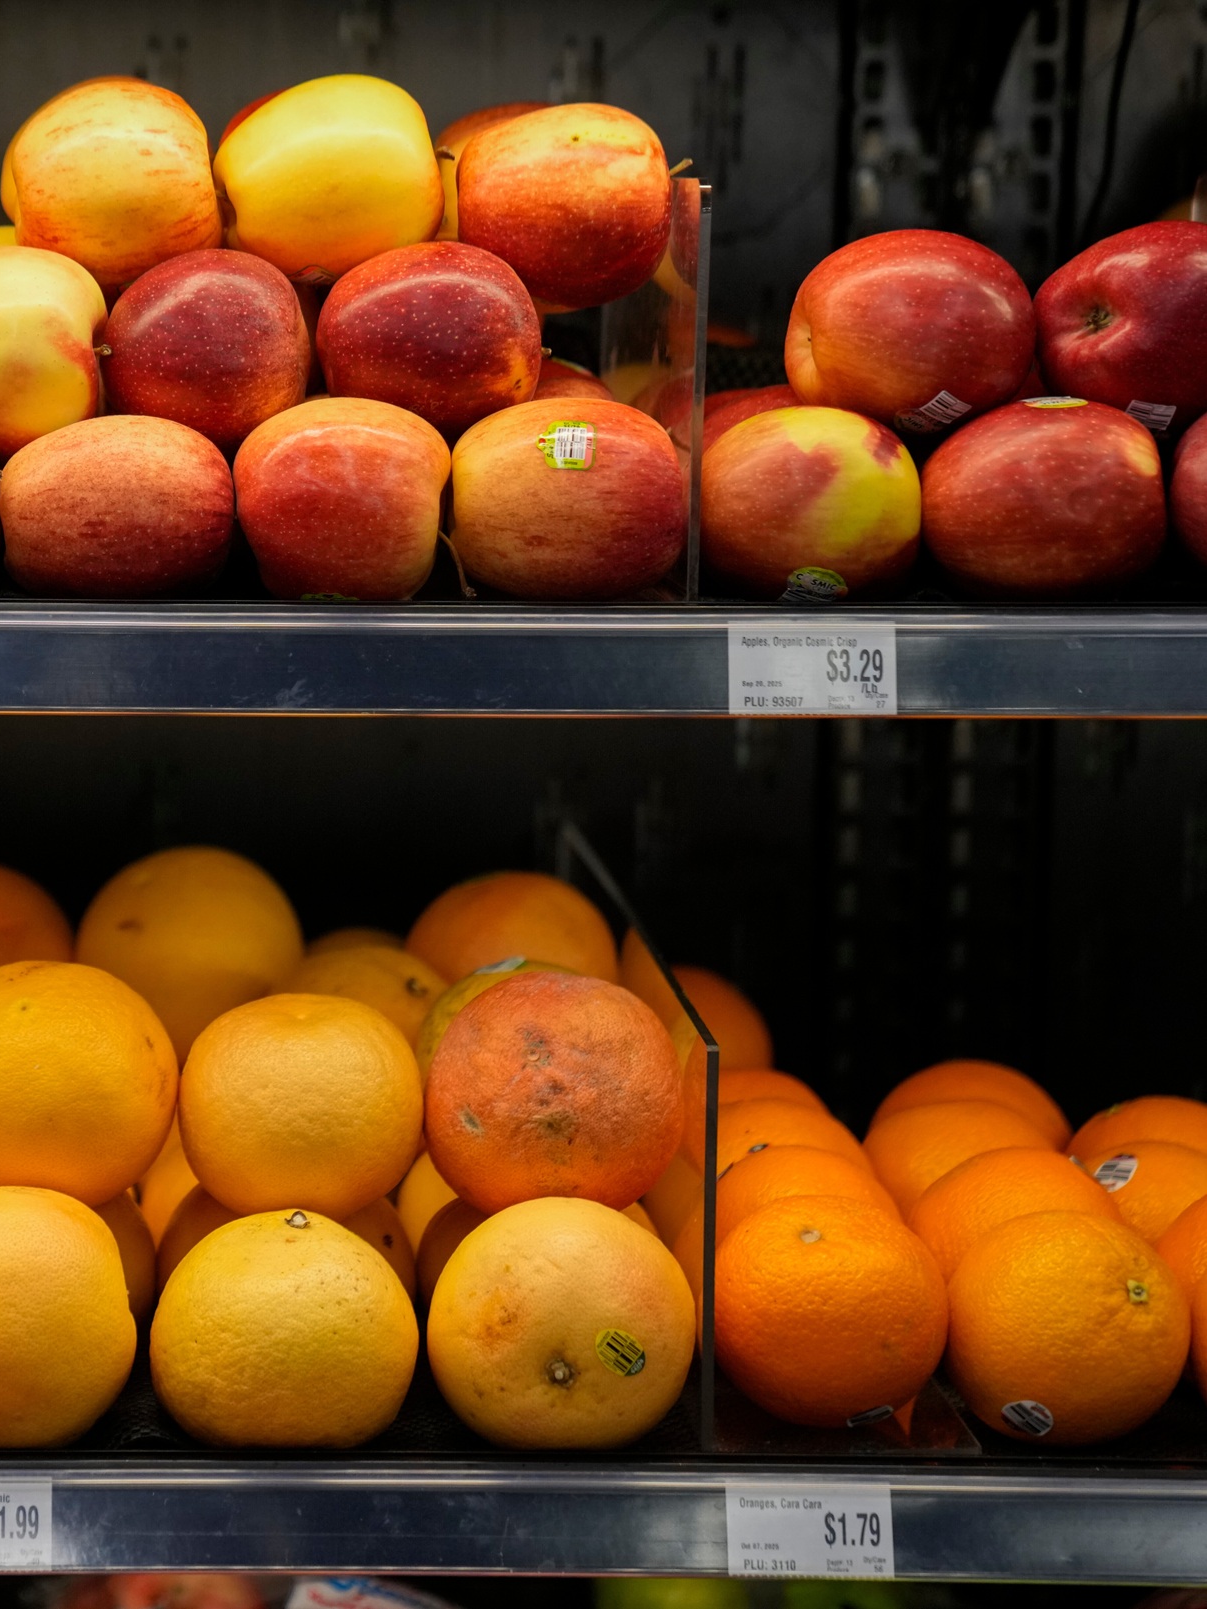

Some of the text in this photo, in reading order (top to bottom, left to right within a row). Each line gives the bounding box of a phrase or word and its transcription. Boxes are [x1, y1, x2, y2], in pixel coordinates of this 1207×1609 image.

[796, 573, 838, 591] CSMIC
[741, 636, 857, 648] Apples, Organic Cosmic Crisp
[826, 648, 883, 685] $3.29
[861, 683, 878, 694] /Lb
[744, 696, 803, 707] PLU: 93507
[740, 1497, 822, 1510] Oranges, Cara Cara
[824, 1511, 880, 1548] $1.79
[744, 1559, 796, 1571] PLU: 3110
